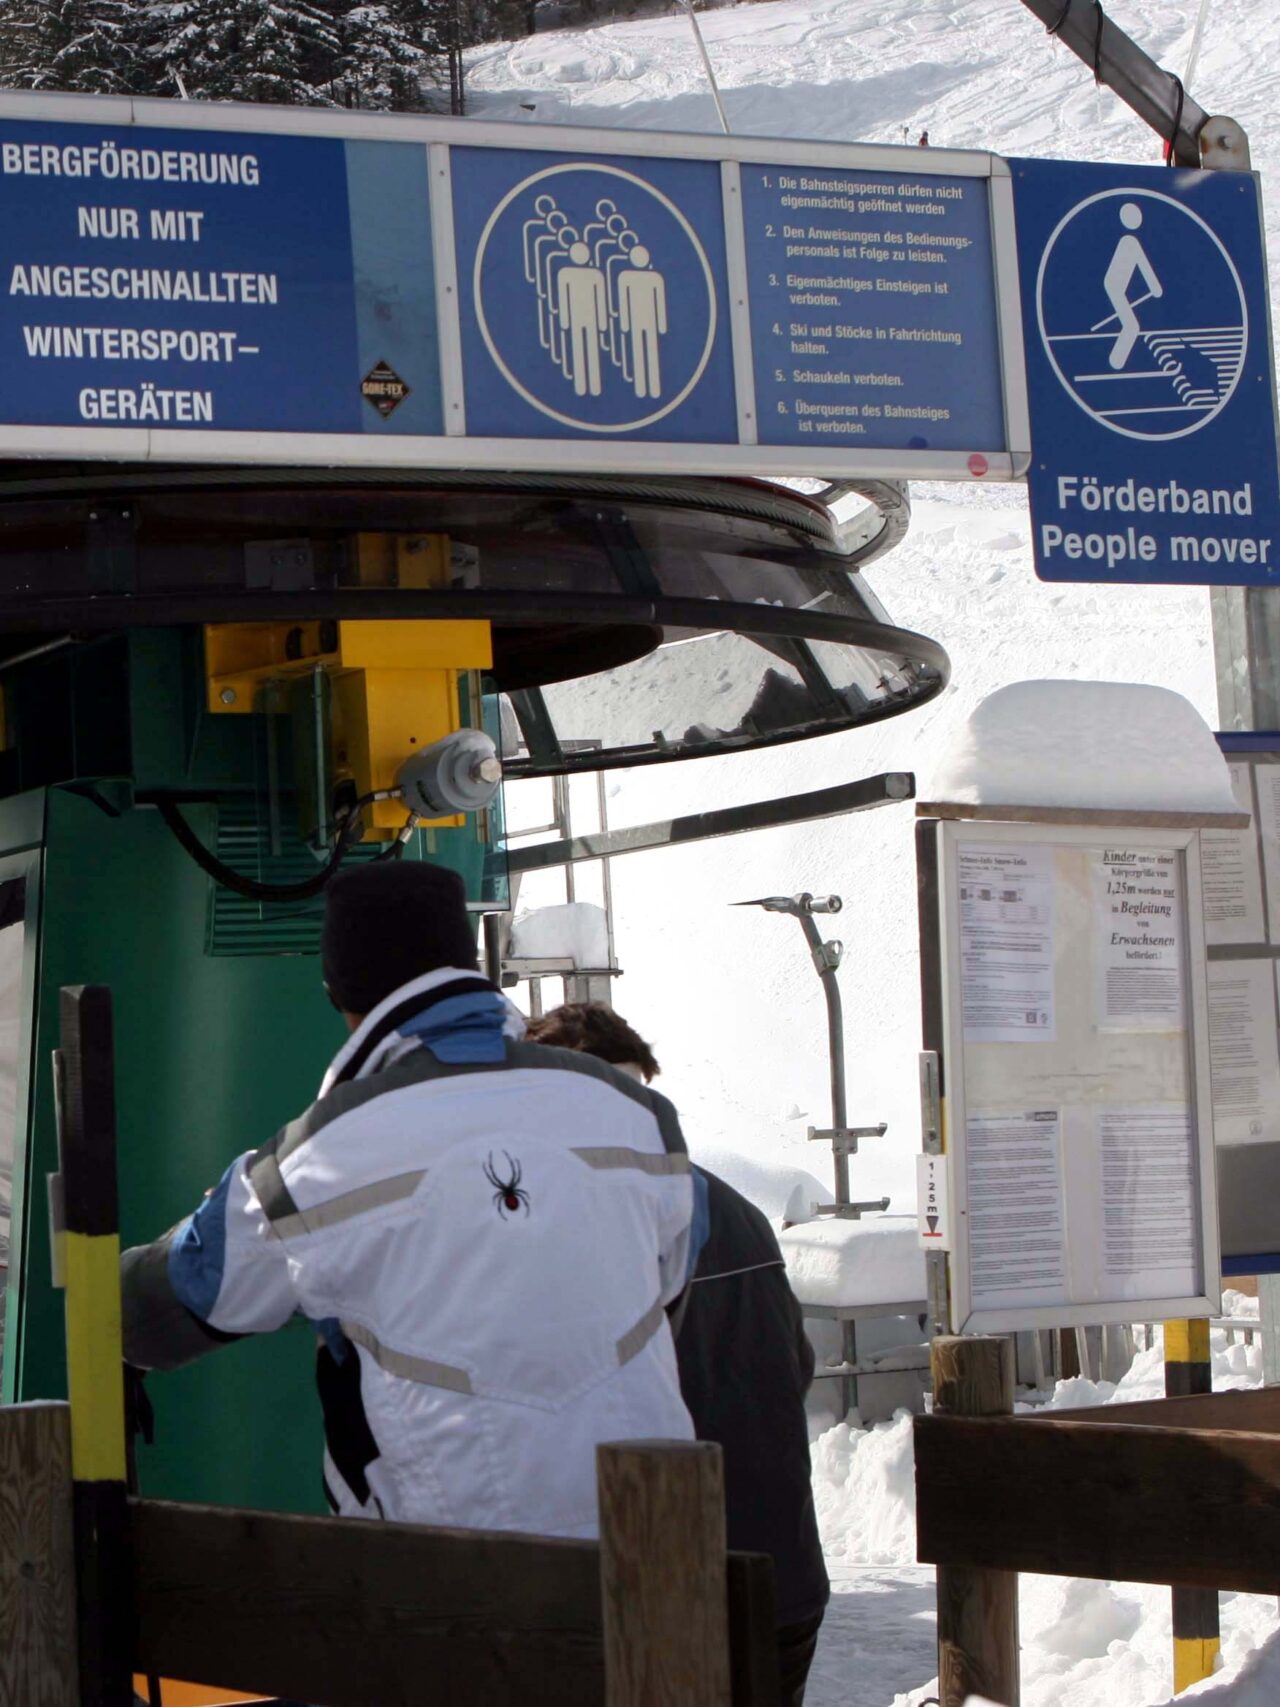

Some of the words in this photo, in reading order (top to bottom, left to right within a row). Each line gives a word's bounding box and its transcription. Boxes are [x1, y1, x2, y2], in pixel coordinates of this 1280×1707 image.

[2, 141, 260, 186] BERGFÖRDERUNG
[762, 176, 773, 189] 1.
[779, 176, 798, 190] Die
[800, 178, 895, 196] Bahnsteigsperren
[898, 183, 933, 198] dürfen
[935, 185, 963, 199] nicht
[781, 195, 855, 212] eigenmächtig
[858, 199, 902, 214] geöffnet
[905, 202, 945, 215] werden
[78, 206, 140, 239] NUR
[150, 209, 204, 242] MIT
[765, 224, 776, 238] 2.
[783, 226, 805, 239] Den
[808, 226, 881, 244] Anweisungen
[884, 230, 903, 244] des
[906, 231, 973, 248] Bedienungs-
[786, 244, 841, 257] personals
[843, 245, 857, 258] ist
[859, 247, 889, 262] Folge
[892, 250, 906, 261] zu
[908, 249, 947, 263] leisten.
[9, 265, 278, 304] ANGESCHNALLTEN
[769, 274, 780, 287] 3.
[786, 274, 873, 292] Eigenmächtiges
[876, 279, 932, 295] Einsteigen
[934, 282, 948, 294] ist
[789, 293, 842, 306] verboten.
[772, 324, 783, 337] 4.
[790, 324, 808, 336] Ski
[811, 325, 832, 338] und
[835, 326, 873, 339] Stöcke
[876, 327, 887, 339] in
[889, 329, 962, 345] Fahrtrichtung
[791, 341, 829, 354] halten.
[775, 369, 787, 382] 5.
[793, 370, 851, 384] Schaukeln
[853, 373, 904, 386] verboten.
[79, 382, 213, 422] GERÄTEN
[777, 402, 788, 414] 6.
[795, 399, 858, 417] Überqueren
[862, 403, 881, 416] des
[884, 404, 950, 421] Bahnsteiges
[799, 419, 812, 432] ist
[816, 421, 867, 434] verboten.
[1057, 476, 1252, 515] Förderband
[1041, 524, 1157, 568] People
[1171, 535, 1271, 564] mover
[1103, 849, 1137, 863] Kinder
[1107, 882, 1136, 895] 1,25m
[1121, 901, 1172, 917] Begleitung
[1110, 932, 1175, 946] Erwachsenen
